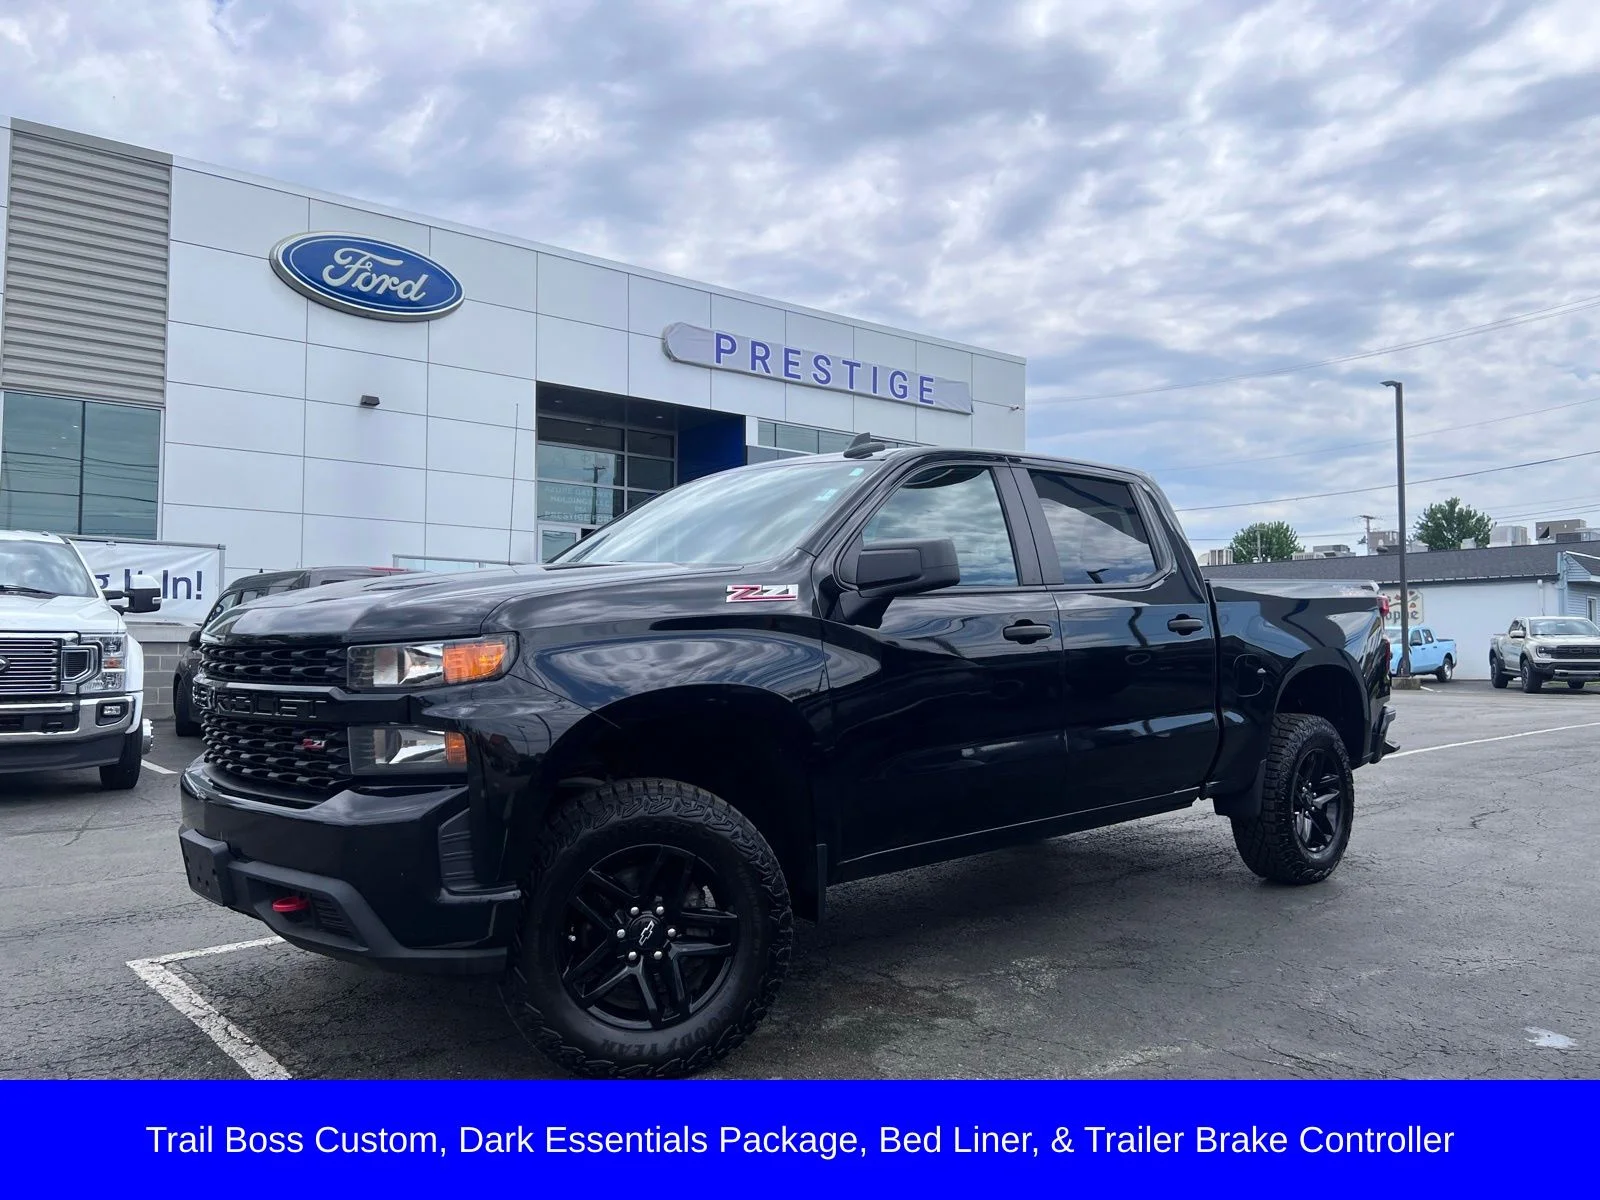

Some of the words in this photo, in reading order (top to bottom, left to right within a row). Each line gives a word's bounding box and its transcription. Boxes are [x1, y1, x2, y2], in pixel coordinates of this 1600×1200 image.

[322, 247, 429, 301] Ford
[714, 332, 935, 405] PRESTIGE
[162, 570, 202, 599] In!
[726, 584, 798, 602] Z71
